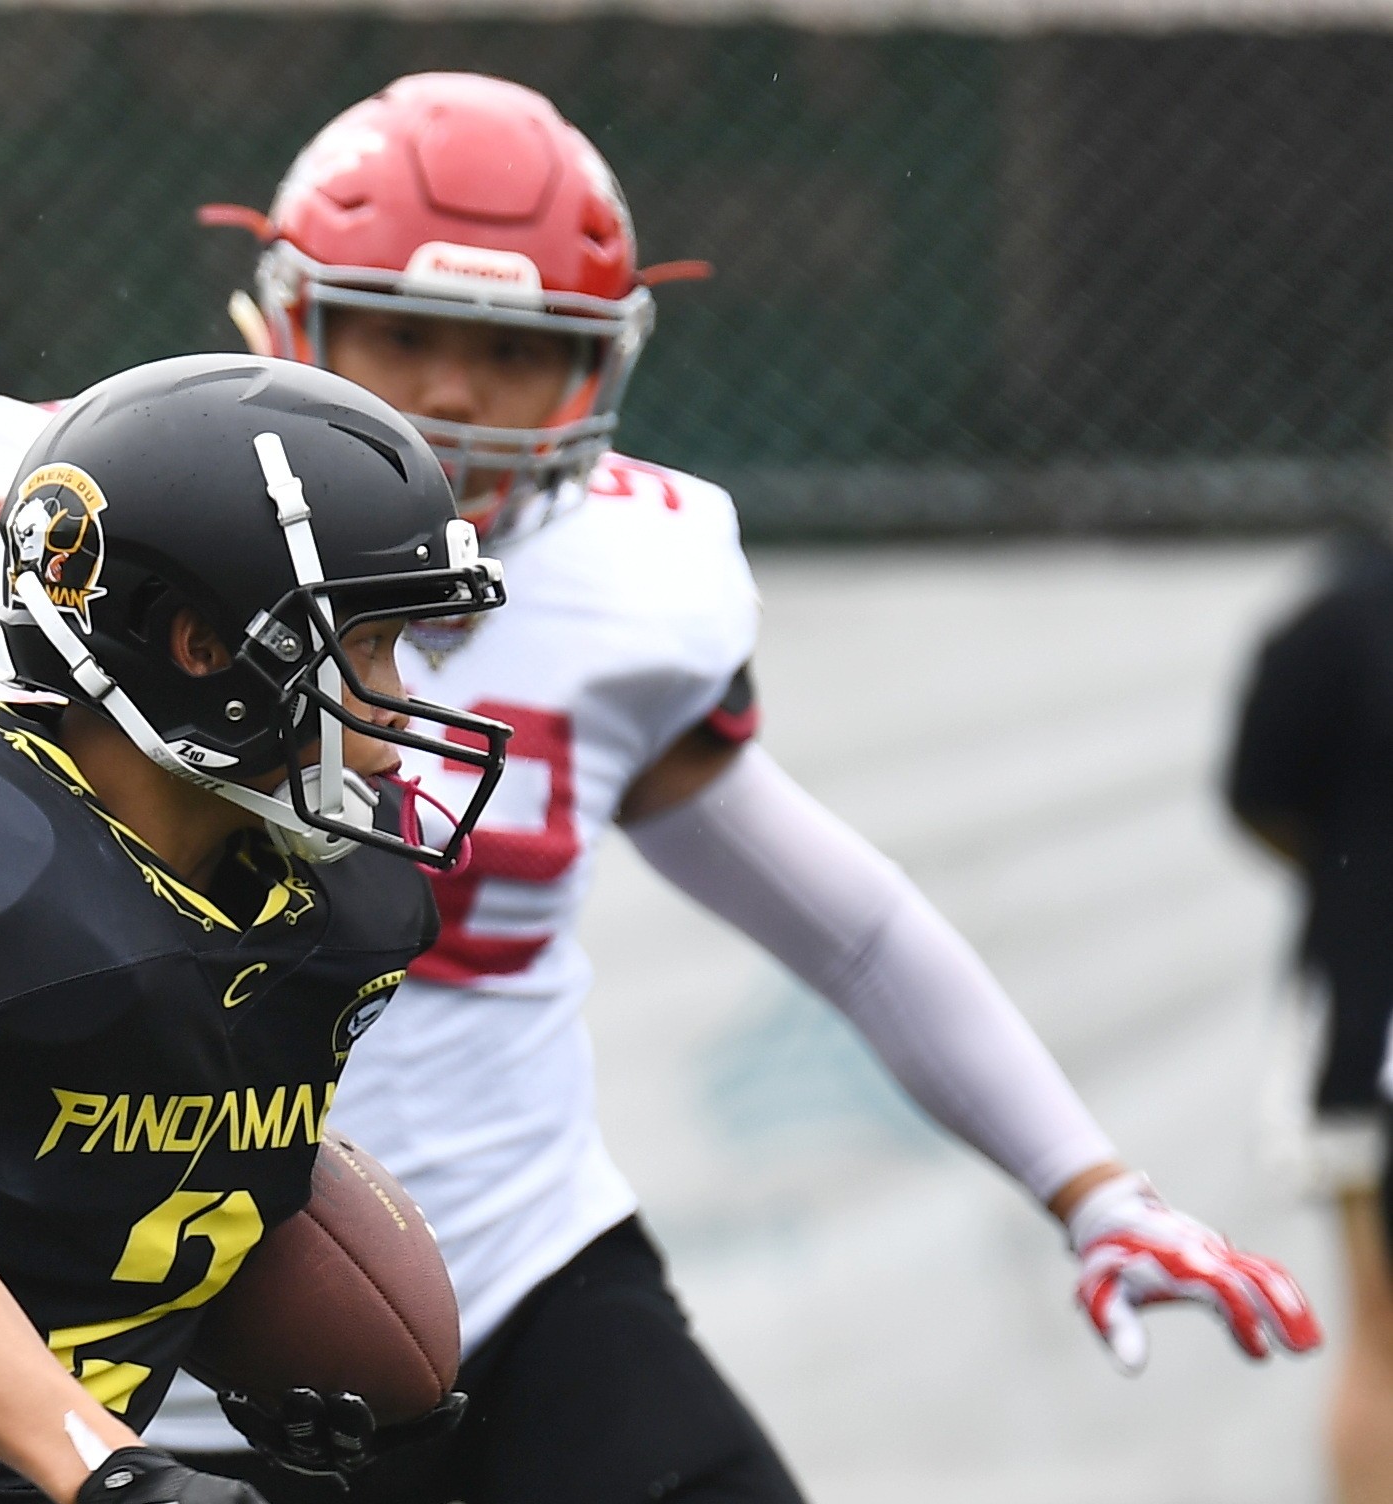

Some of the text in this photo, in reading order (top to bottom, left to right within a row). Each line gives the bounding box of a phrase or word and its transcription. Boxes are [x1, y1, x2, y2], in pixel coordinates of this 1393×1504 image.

[76, 482, 95, 502] DU
[176, 742, 206, 763] Z10
[223, 962, 268, 1008] C
[47, 1190, 264, 1414] 2
